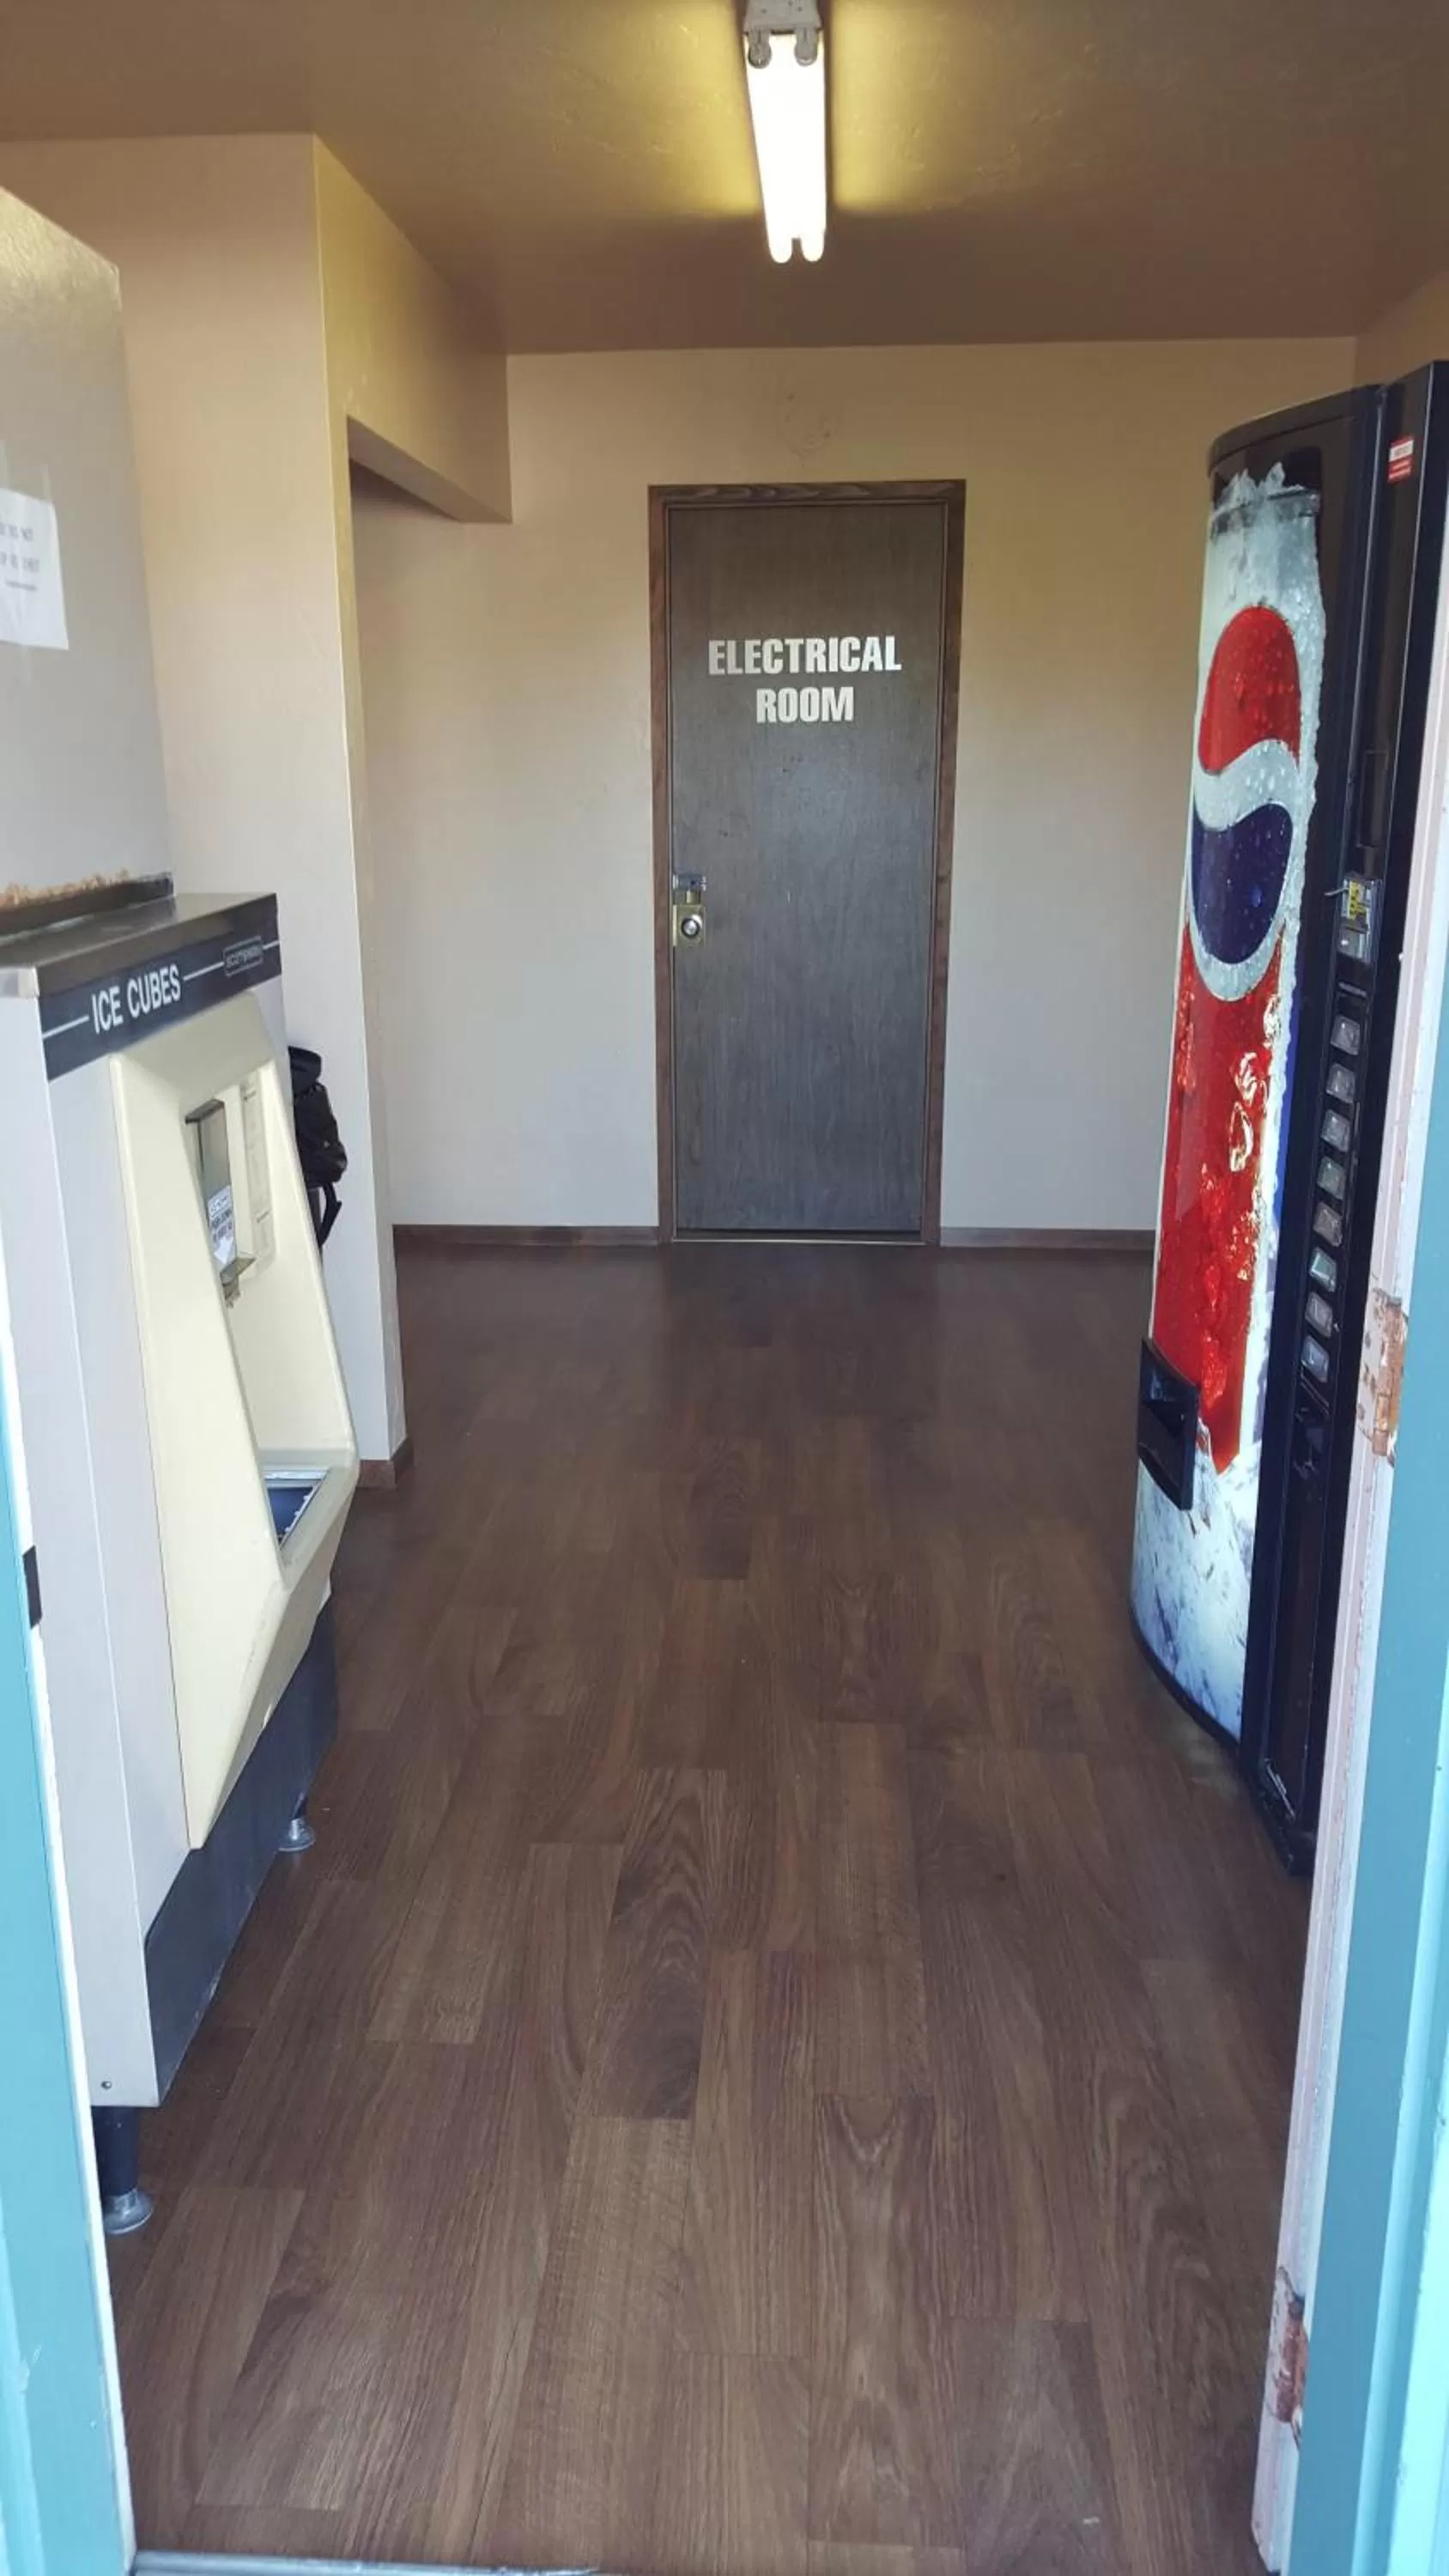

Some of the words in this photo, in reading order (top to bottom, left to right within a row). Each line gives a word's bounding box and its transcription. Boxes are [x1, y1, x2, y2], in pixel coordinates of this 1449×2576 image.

[708, 635, 902, 675] ELECTRICAL
[756, 687, 854, 723] ROOM
[92, 986, 124, 1034] ICE
[127, 963, 180, 1018] CUBES
